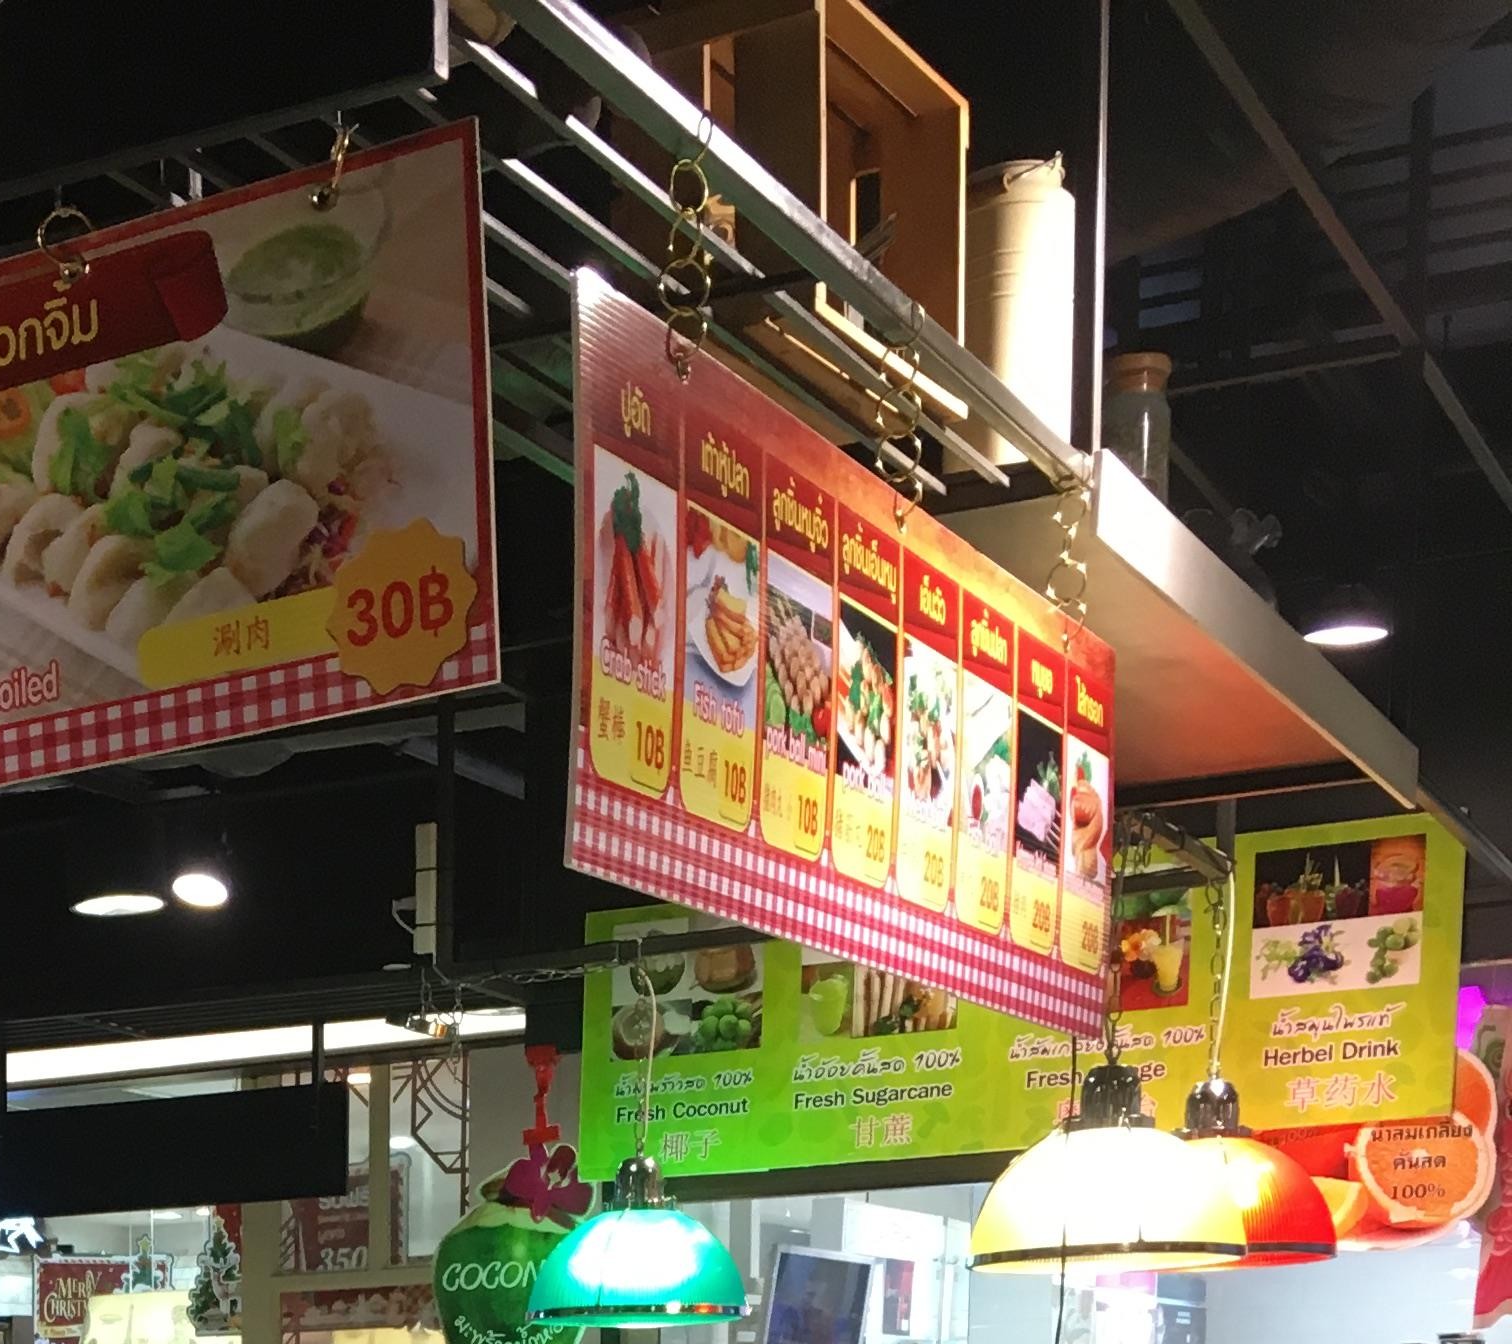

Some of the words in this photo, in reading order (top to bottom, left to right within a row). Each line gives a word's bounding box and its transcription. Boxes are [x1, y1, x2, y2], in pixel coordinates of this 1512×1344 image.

[600, 637, 632, 686] Crab
[638, 660, 666, 702] stick
[694, 680, 717, 727] Fish
[721, 695, 745, 738] tofu
[767, 724, 787, 760] pork
[913, 1049, 961, 1070] 100%
[1263, 1045, 1333, 1068] Herbel
[1342, 1038, 1400, 1061] Drink
[1026, 1070, 1082, 1089] Fresh
[794, 1091, 845, 1110] Fresh
[853, 1082, 953, 1106] Sugarcane
[616, 1105, 666, 1123] Fresh
[672, 1099, 749, 1120] Coconut
[1390, 1183, 1446, 1200] 100%
